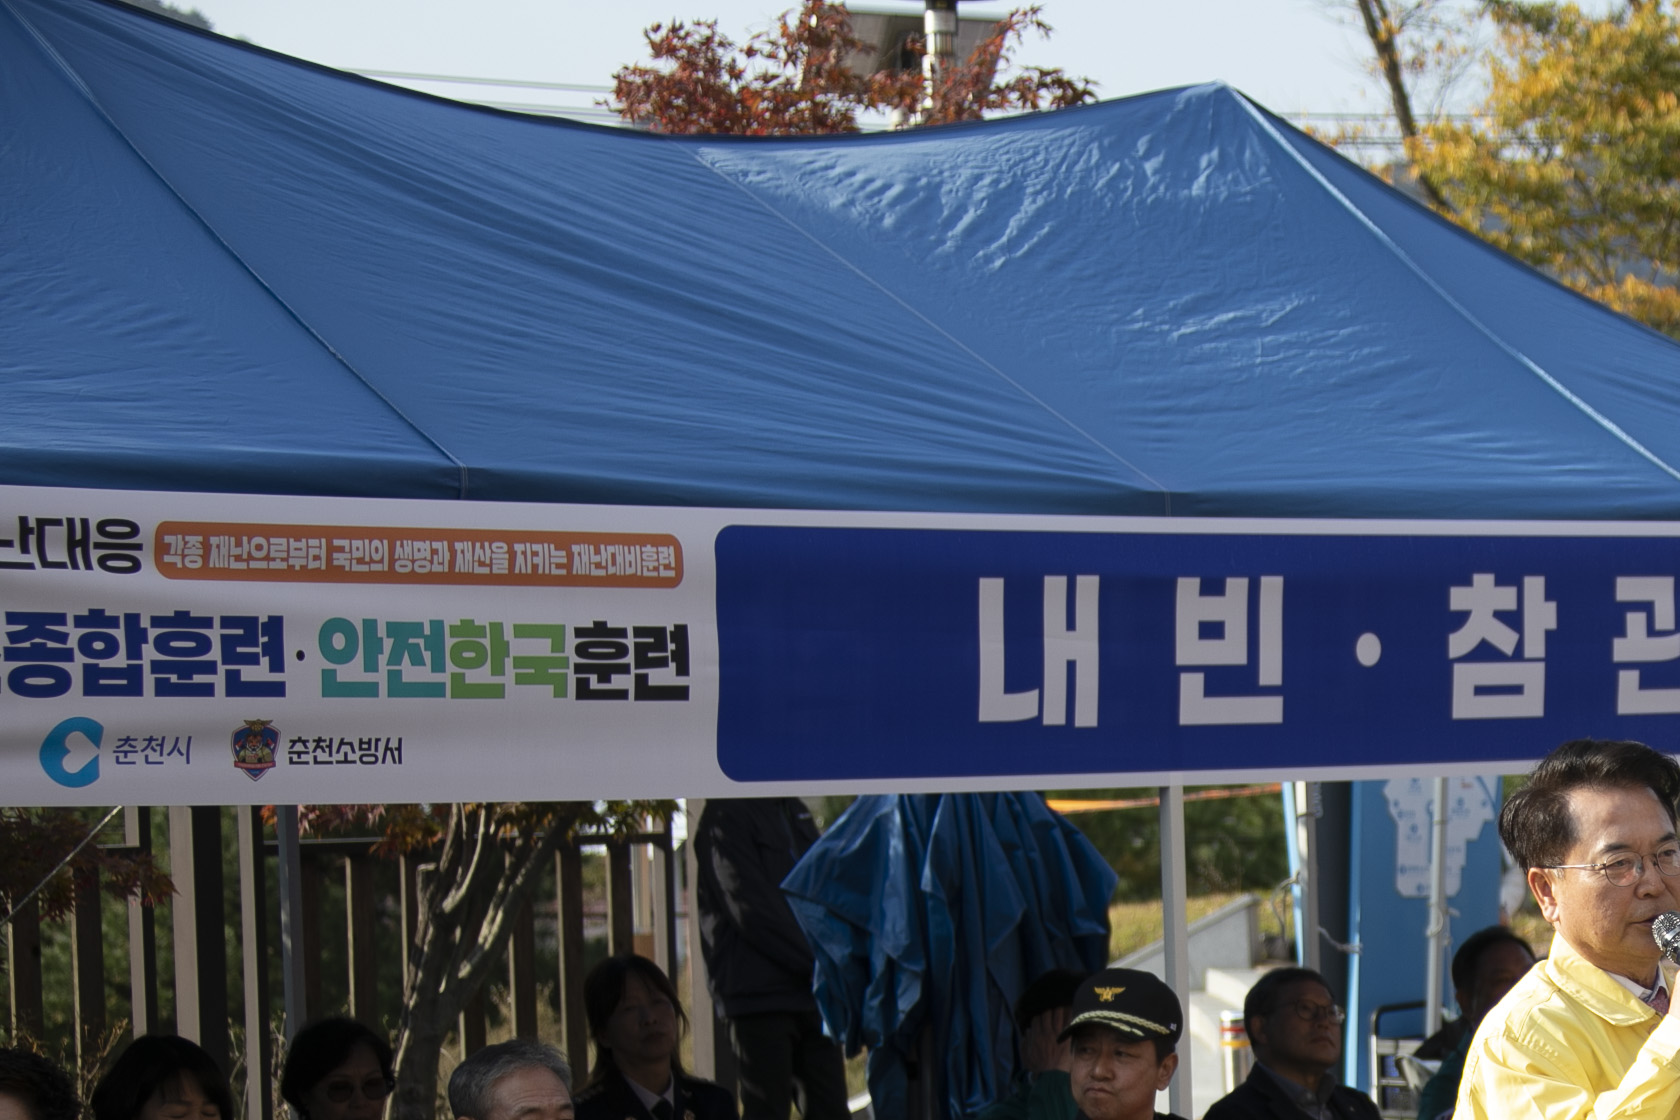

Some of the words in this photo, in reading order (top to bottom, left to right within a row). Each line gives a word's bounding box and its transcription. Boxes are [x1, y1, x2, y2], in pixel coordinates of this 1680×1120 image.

[163, 535, 203, 569] 각종
[209, 535, 326, 570] 재난으로부터
[332, 538, 389, 572] 국민의
[394, 539, 450, 573] 생명과
[454, 541, 509, 575] 재산을
[513, 542, 567, 575] 지키는
[571, 543, 676, 578] 재난대비훈련
[112, 734, 193, 767] 춘천시
[287, 735, 404, 767] 춘천소방서
